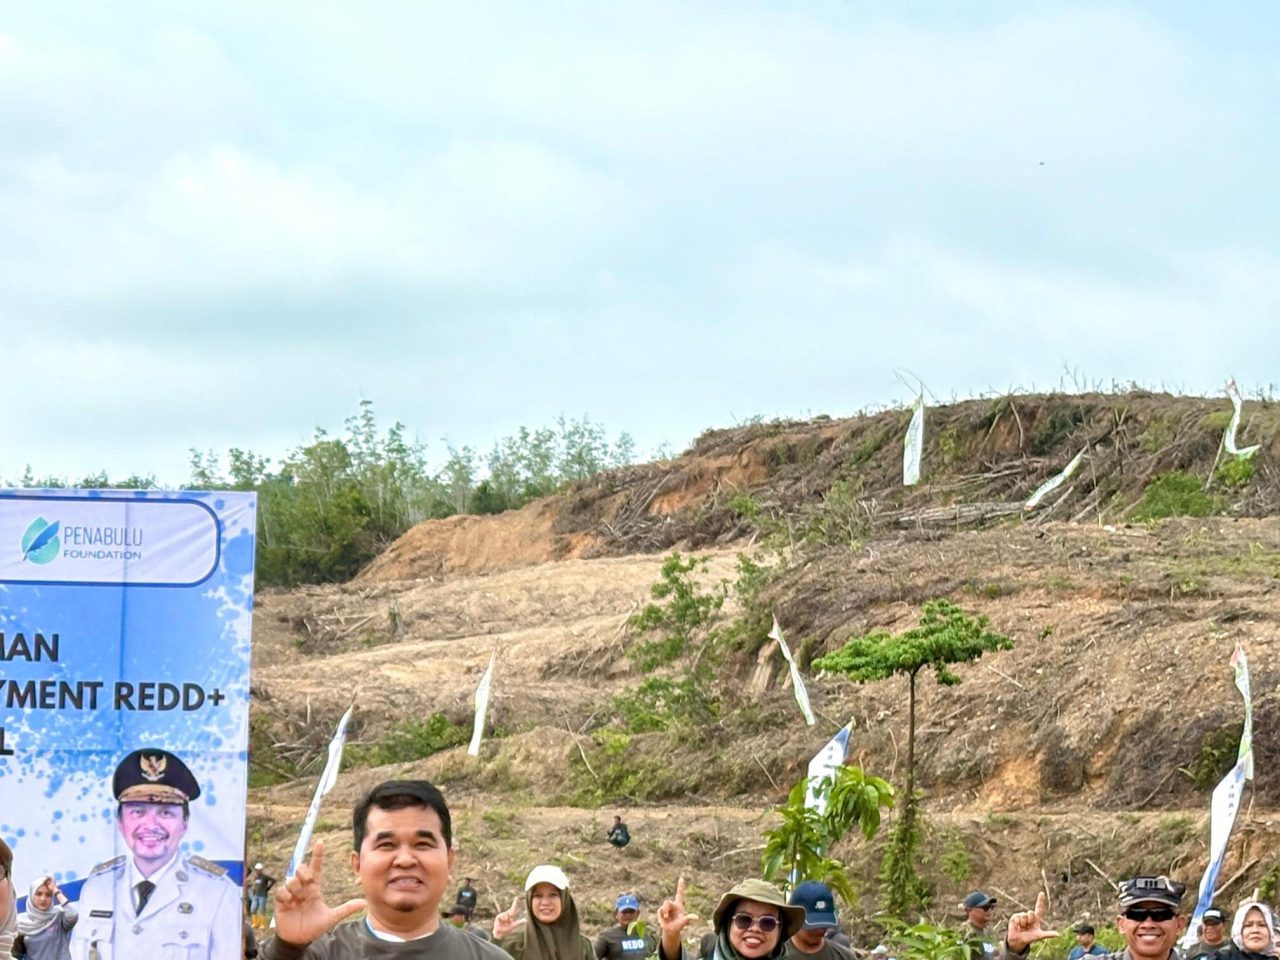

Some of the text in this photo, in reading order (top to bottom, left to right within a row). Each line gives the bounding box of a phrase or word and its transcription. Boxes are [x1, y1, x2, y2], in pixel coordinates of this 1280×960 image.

[63, 526, 143, 547] PENABULU
[63, 549, 142, 560] FOUNDATION
[114, 682, 225, 712] REDD+
